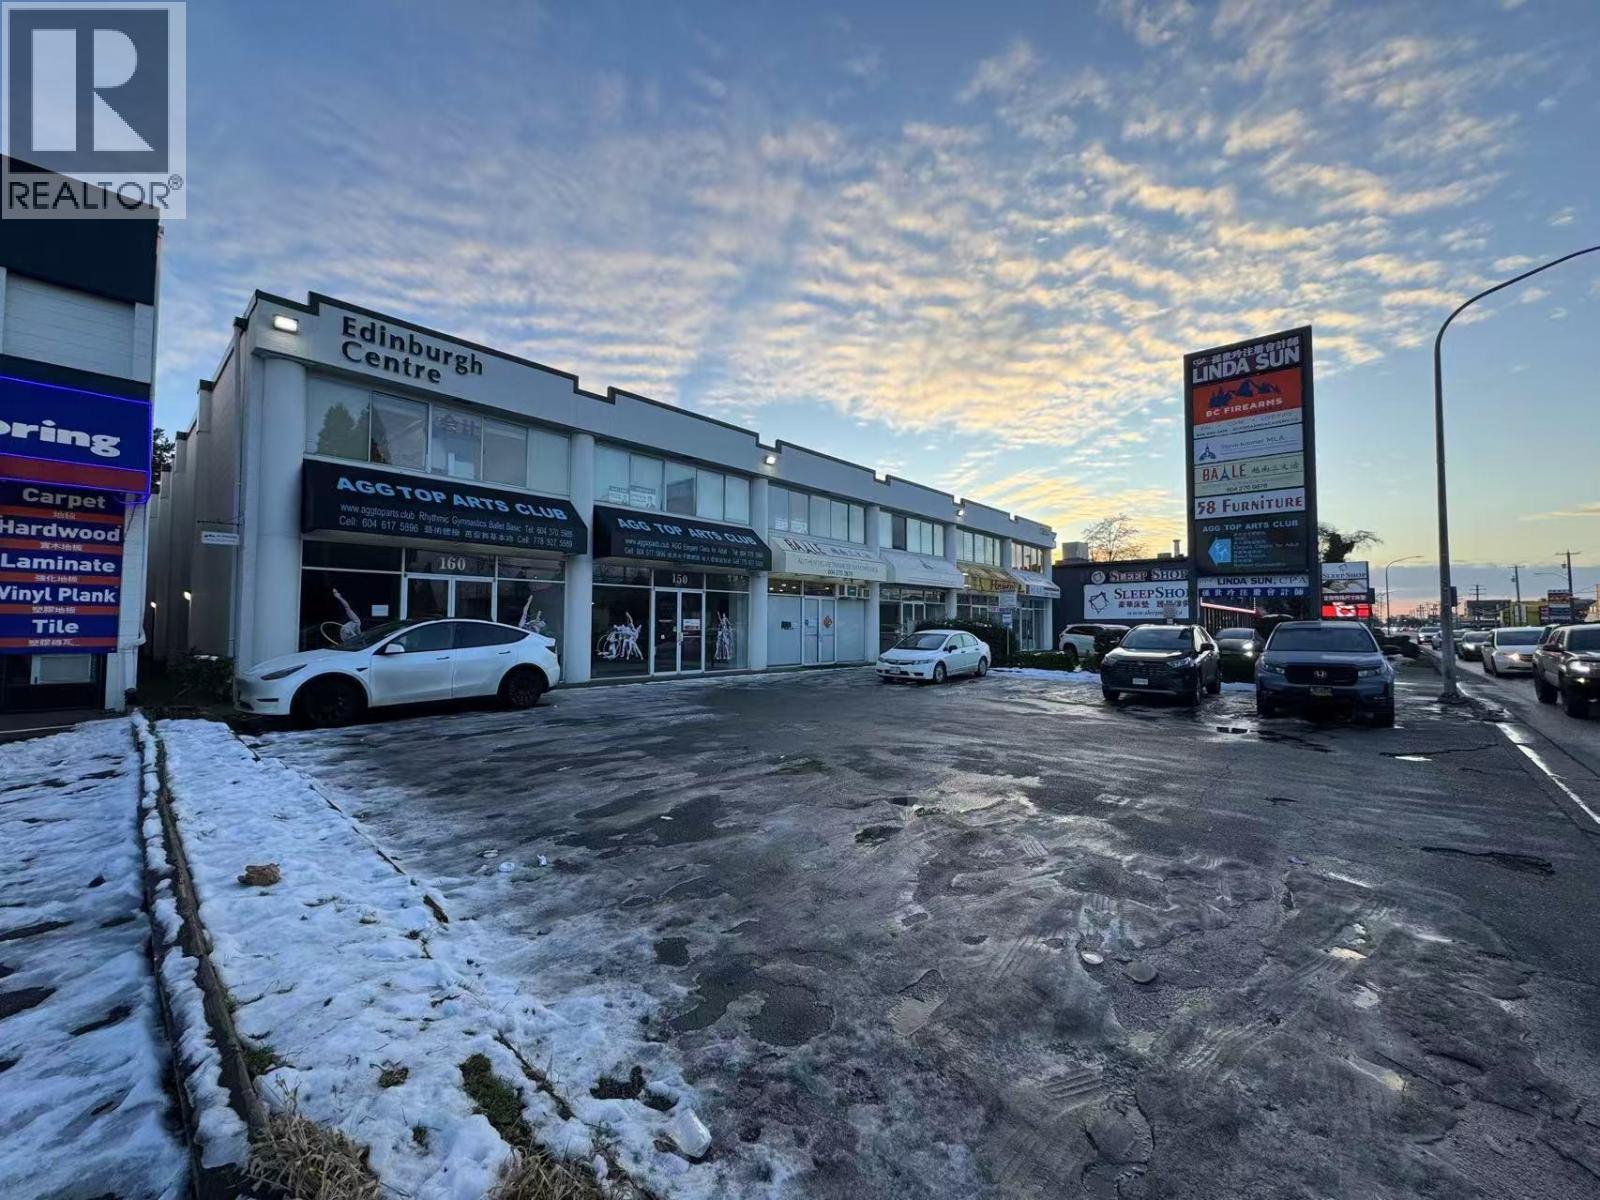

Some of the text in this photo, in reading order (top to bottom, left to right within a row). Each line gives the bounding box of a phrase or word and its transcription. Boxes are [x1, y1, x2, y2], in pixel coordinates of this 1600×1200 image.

[342, 316, 483, 376] Edinburgh
[341, 340, 441, 384] Centre
[1193, 345, 1300, 384] LINDA SUN
[1224, 397, 1284, 415] FIREARMS
[22, 487, 107, 509] Carpet
[337, 477, 568, 520] AGG TOP ARTS CLUB
[0, 519, 121, 542] Hardwood
[362, 518, 377, 528] 604
[381, 520, 396, 530] 617
[617, 518, 757, 545] AGG TOP ARTS CLUB
[1202, 519, 1299, 533] AGG TOP ARTS CLUB
[1, 553, 116, 573] Laminate
[440, 556, 466, 571] 160
[672, 574, 688, 585] 150
[1109, 568, 1189, 582] SLEEP SHOP
[1217, 577, 1248, 586] LINDA
[0, 585, 116, 604] Vinyl Plank
[1114, 586, 1188, 600] SLEEPSHO
[32, 619, 80, 634] Tile
